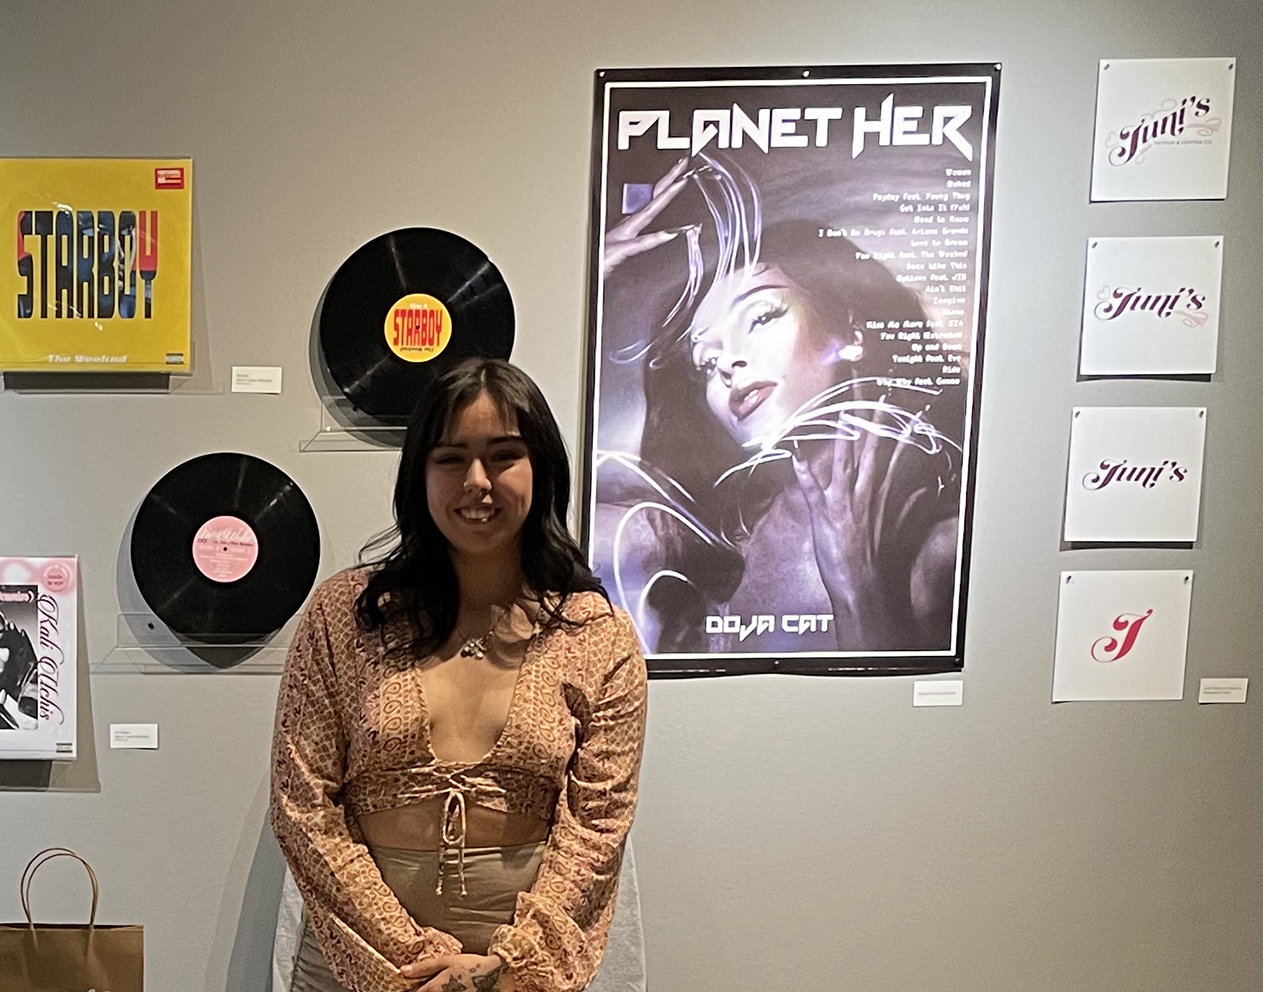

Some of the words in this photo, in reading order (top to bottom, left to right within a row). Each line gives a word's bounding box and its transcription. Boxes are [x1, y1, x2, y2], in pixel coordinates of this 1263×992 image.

[618, 103, 843, 157] PLANET
[852, 93, 973, 161] HER
[17, 210, 159, 319] STARBOY
[1094, 286, 1206, 321] Juni's
[393, 309, 443, 347] STARBOY
[47, 355, 71, 363] The
[1082, 459, 1188, 491] Juni's
[706, 614, 775, 642] DOJA
[781, 614, 834, 635] CAT
